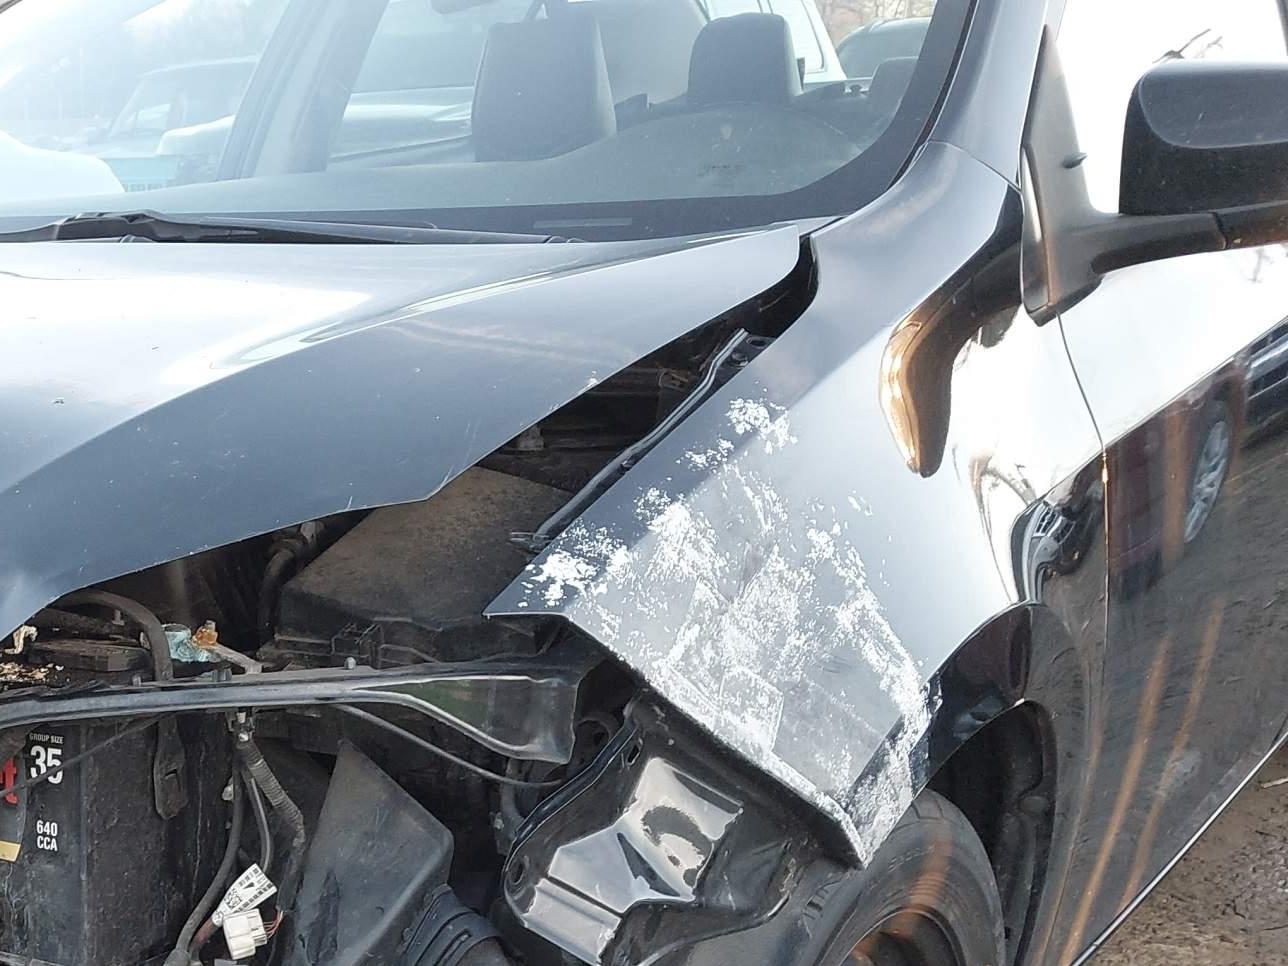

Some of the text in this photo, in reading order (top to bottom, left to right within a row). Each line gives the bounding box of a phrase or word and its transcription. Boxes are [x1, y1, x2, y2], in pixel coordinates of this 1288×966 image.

[29, 732, 64, 745] GROUP SIZE
[30, 745, 64, 784] 35
[36, 819, 58, 837] 640
[36, 835, 58, 852] CCA
